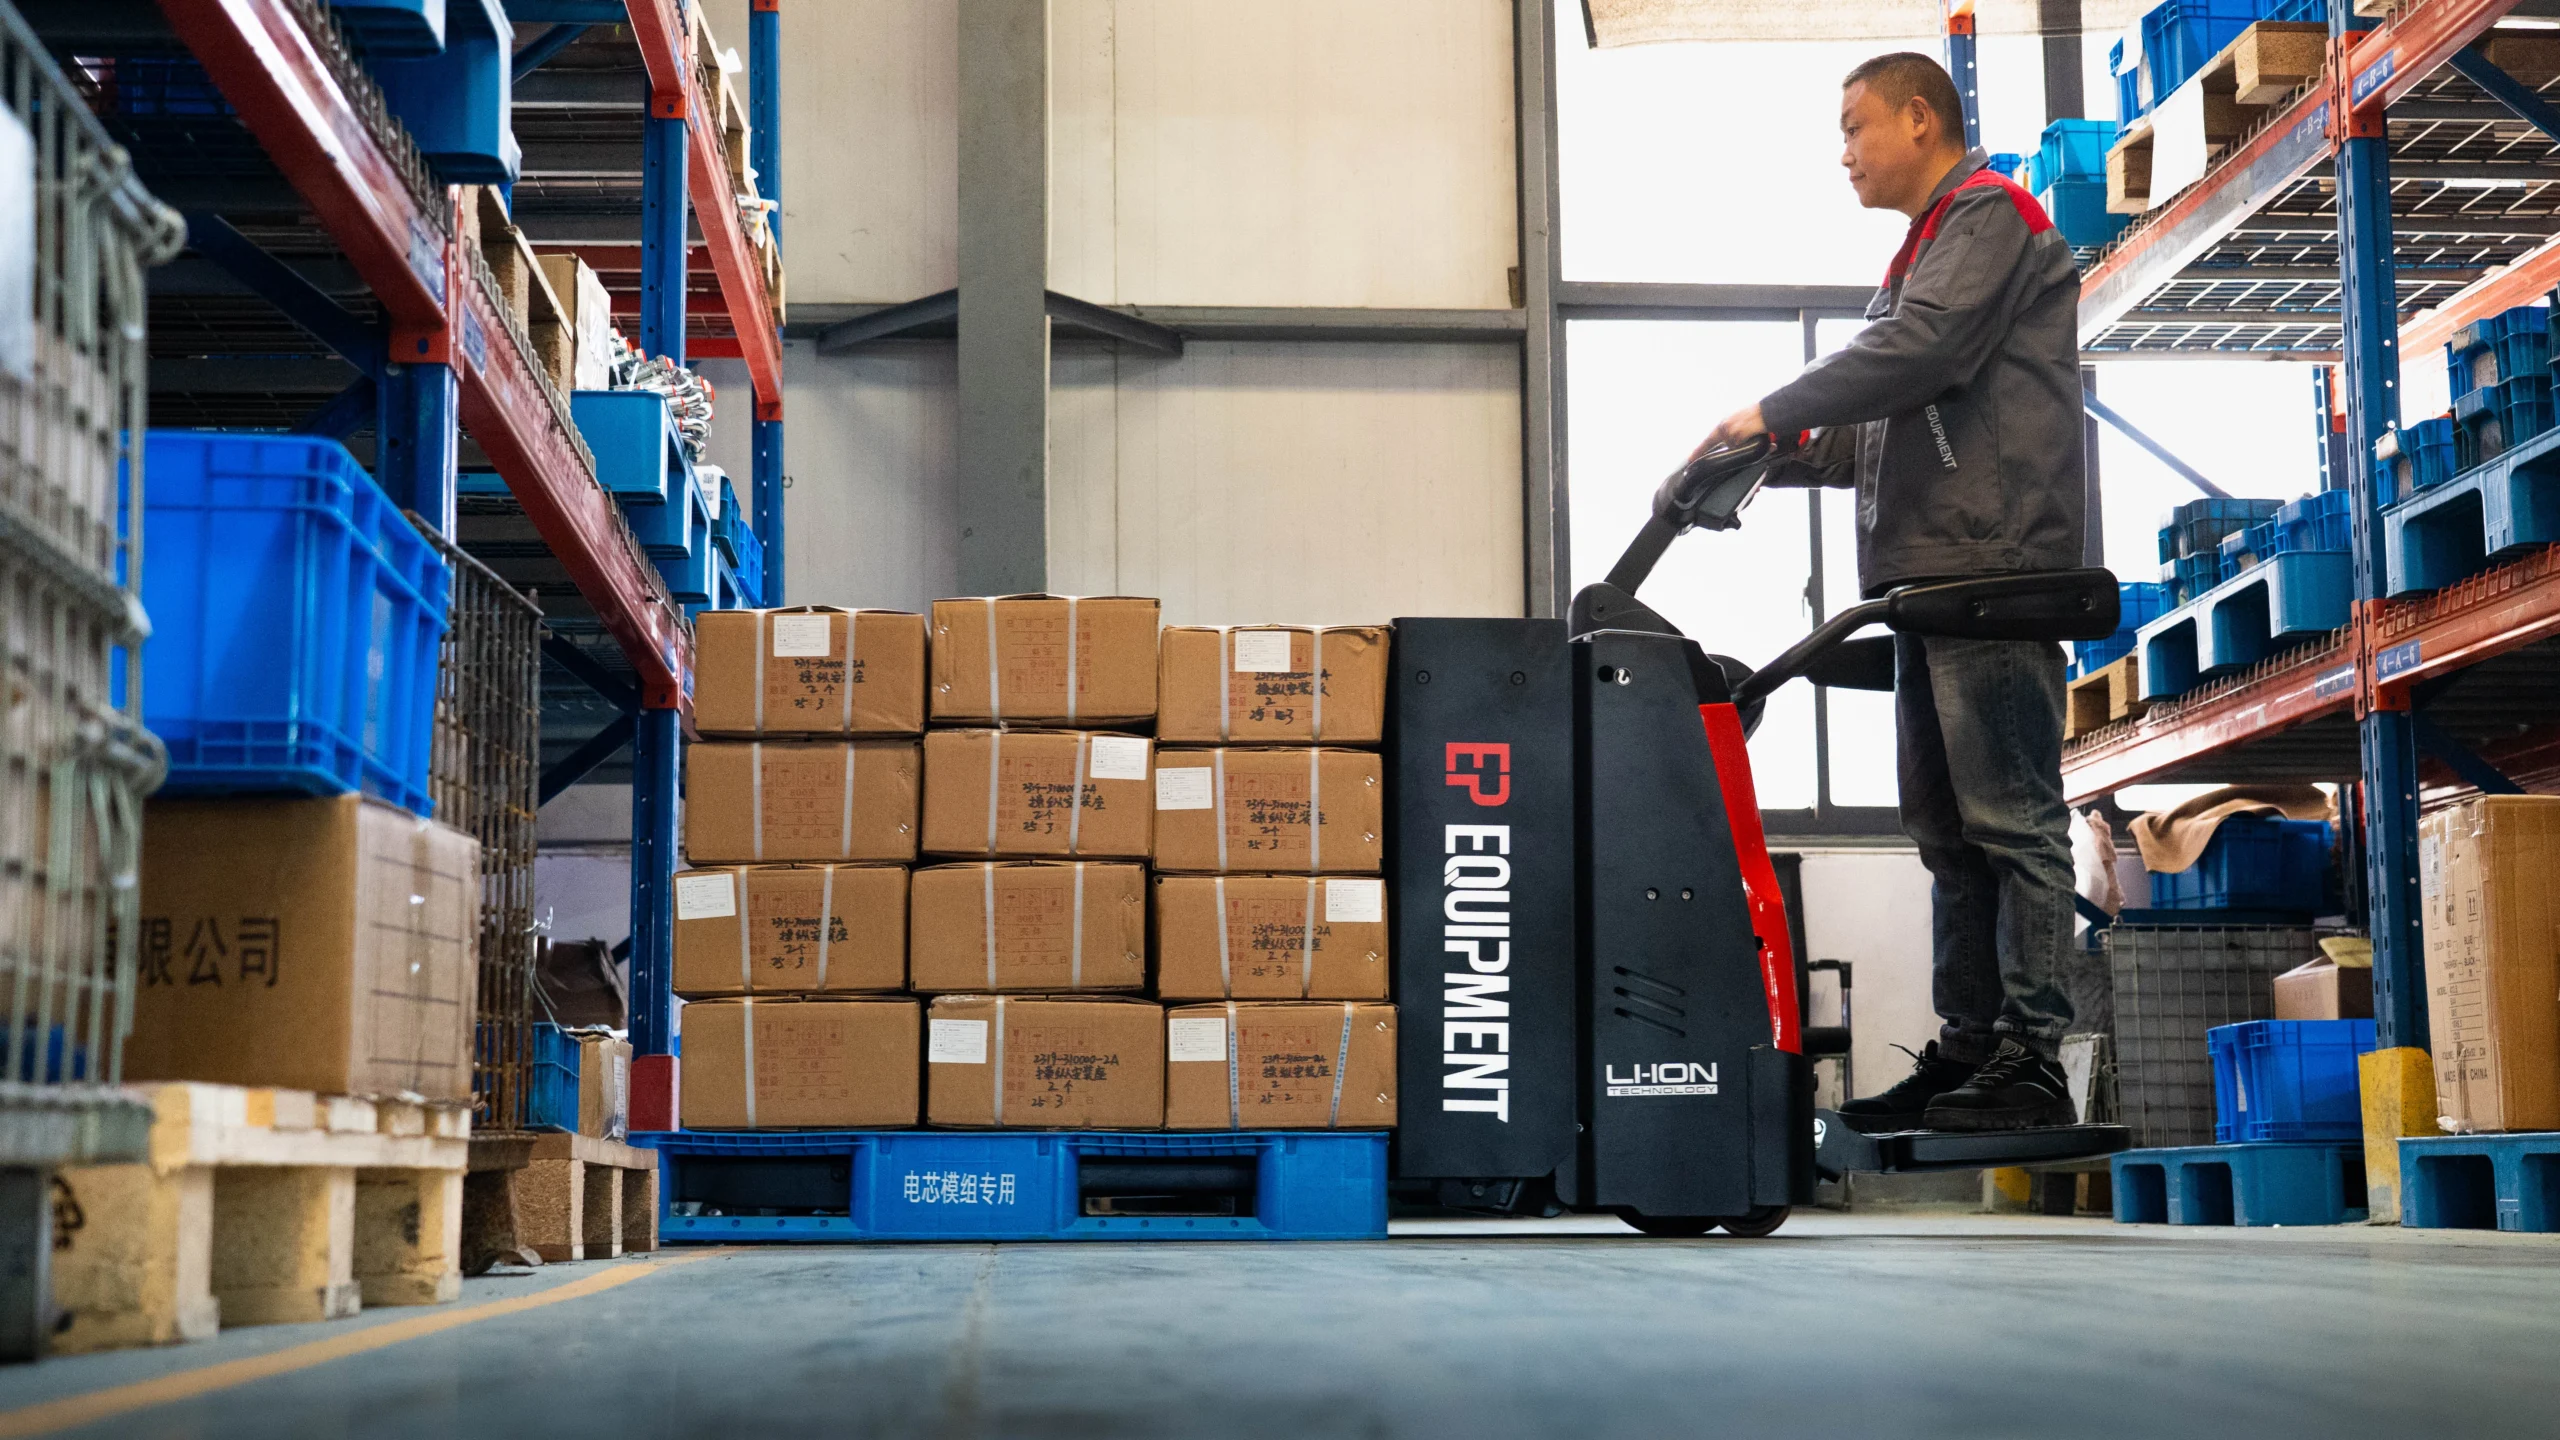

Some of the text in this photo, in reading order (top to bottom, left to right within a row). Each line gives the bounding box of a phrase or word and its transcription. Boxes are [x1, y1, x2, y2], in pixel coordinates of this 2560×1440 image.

[2357, 59, 2388, 97] 4-B-6
[1924, 404, 1957, 468] EQUIPMENT
[2382, 645, 2415, 674] 4-A-6
[1251, 923, 1331, 936] 2319-31000-2A
[1443, 741, 1511, 1124] EP EQUIPMENT
[107, 917, 282, 988] 限公司
[1606, 1062, 1718, 1084] LI-ION
[2470, 1068, 2488, 1081] CHINA
[1609, 1086, 1716, 1095] TECHNOLOGY
[903, 1169, 1016, 1206] 电芯模组专用
